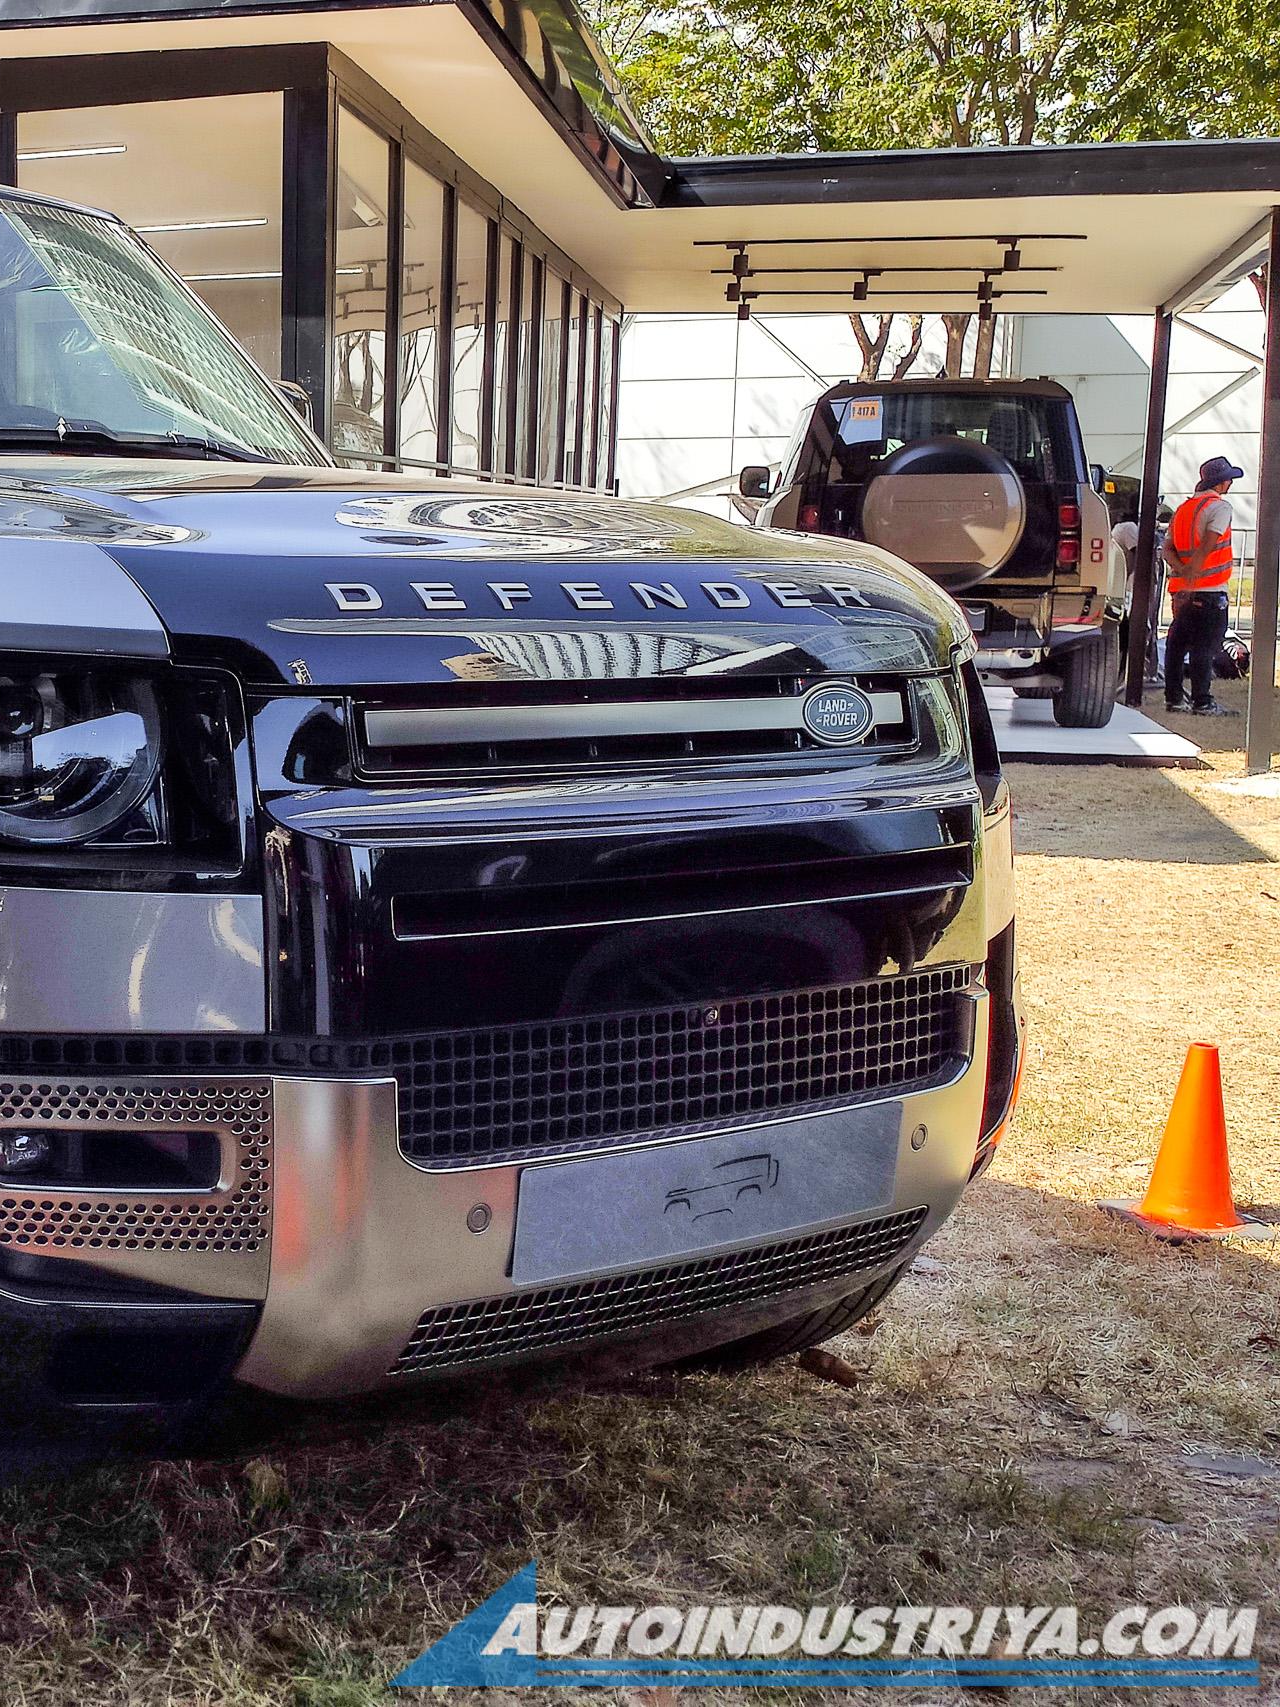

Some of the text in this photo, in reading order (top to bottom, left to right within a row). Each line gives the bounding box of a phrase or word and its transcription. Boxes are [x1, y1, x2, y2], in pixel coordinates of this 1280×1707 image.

[324, 582, 871, 610] DEFENDER
[818, 699, 847, 712] LAND
[823, 712, 857, 726] ROVER
